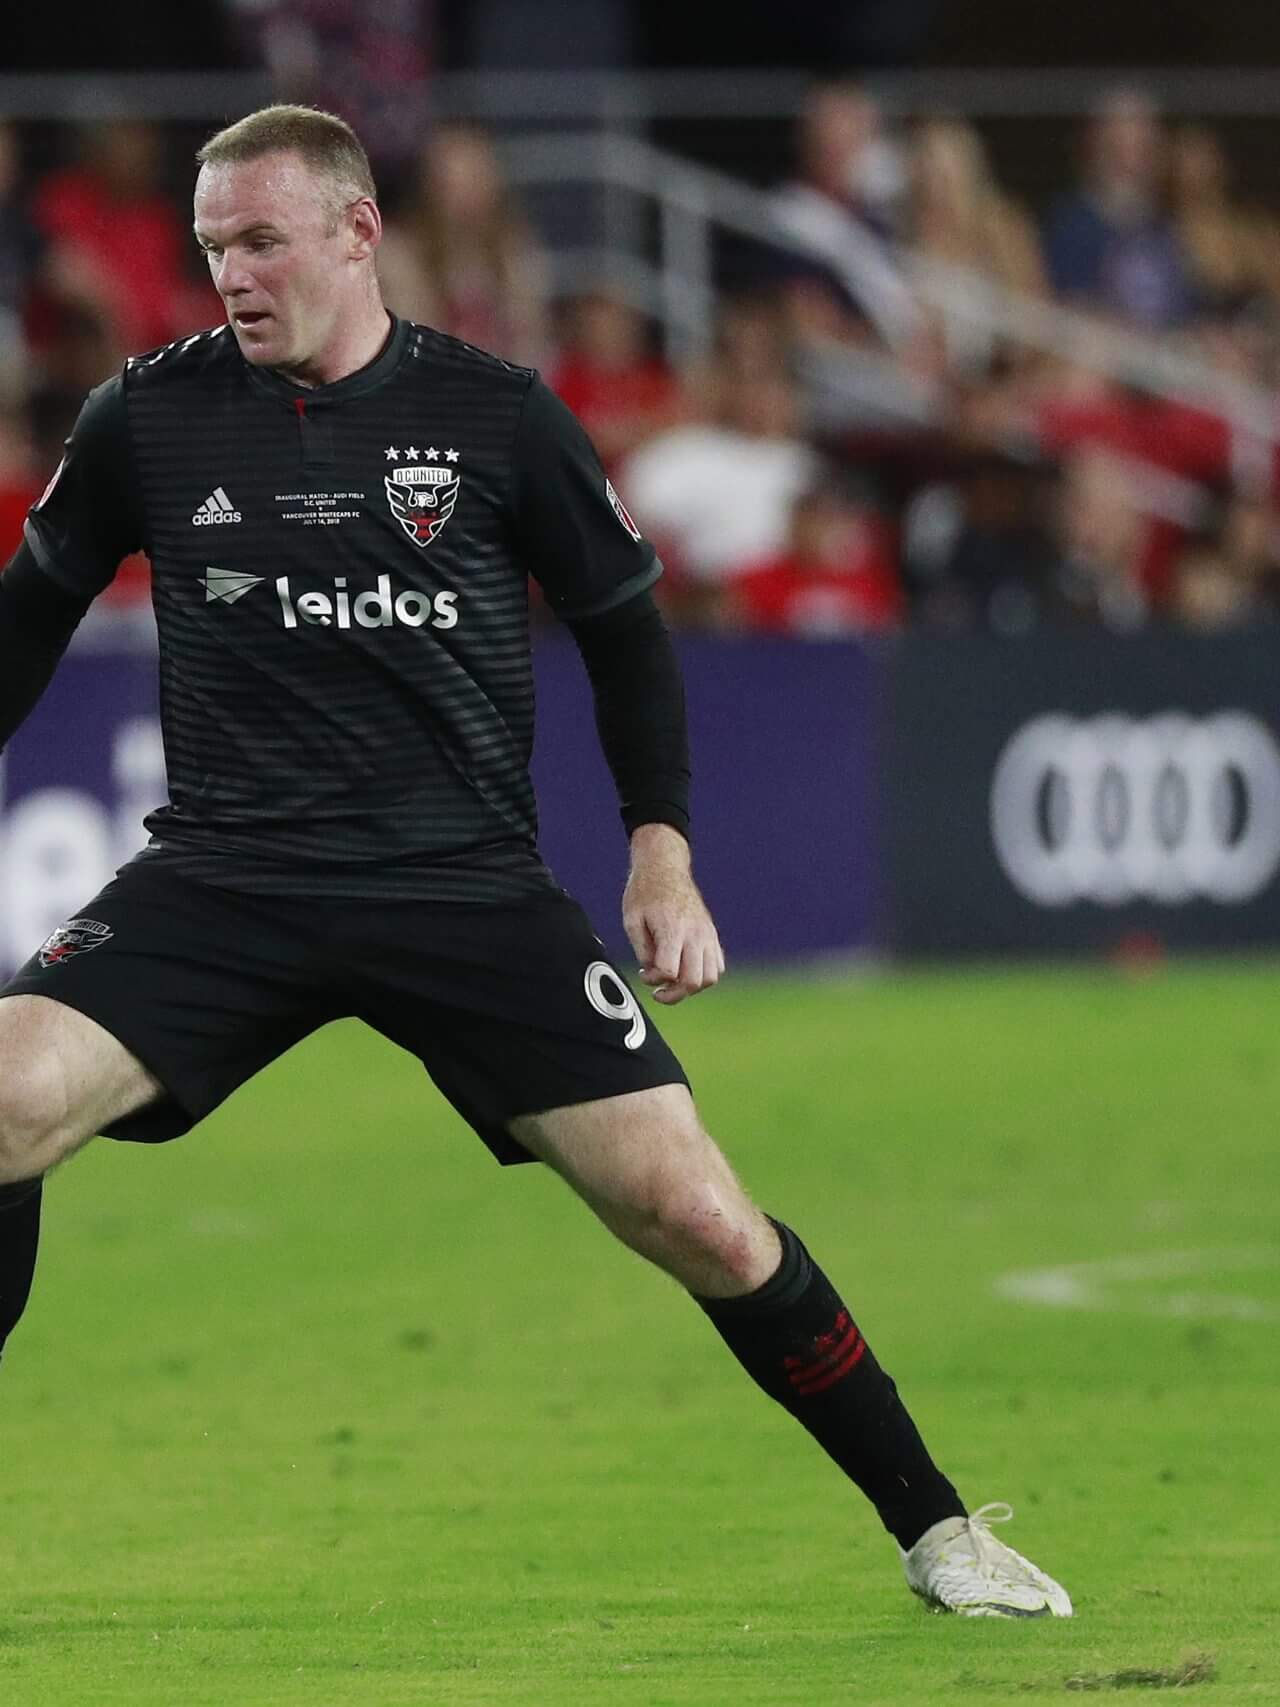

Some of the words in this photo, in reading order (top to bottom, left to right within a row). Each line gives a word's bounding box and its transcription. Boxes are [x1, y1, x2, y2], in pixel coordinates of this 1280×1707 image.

[413, 469, 449, 483] UNITED
[192, 510, 242, 526] adidas
[276, 573, 459, 629] leidos
[584, 961, 646, 1050] 9
